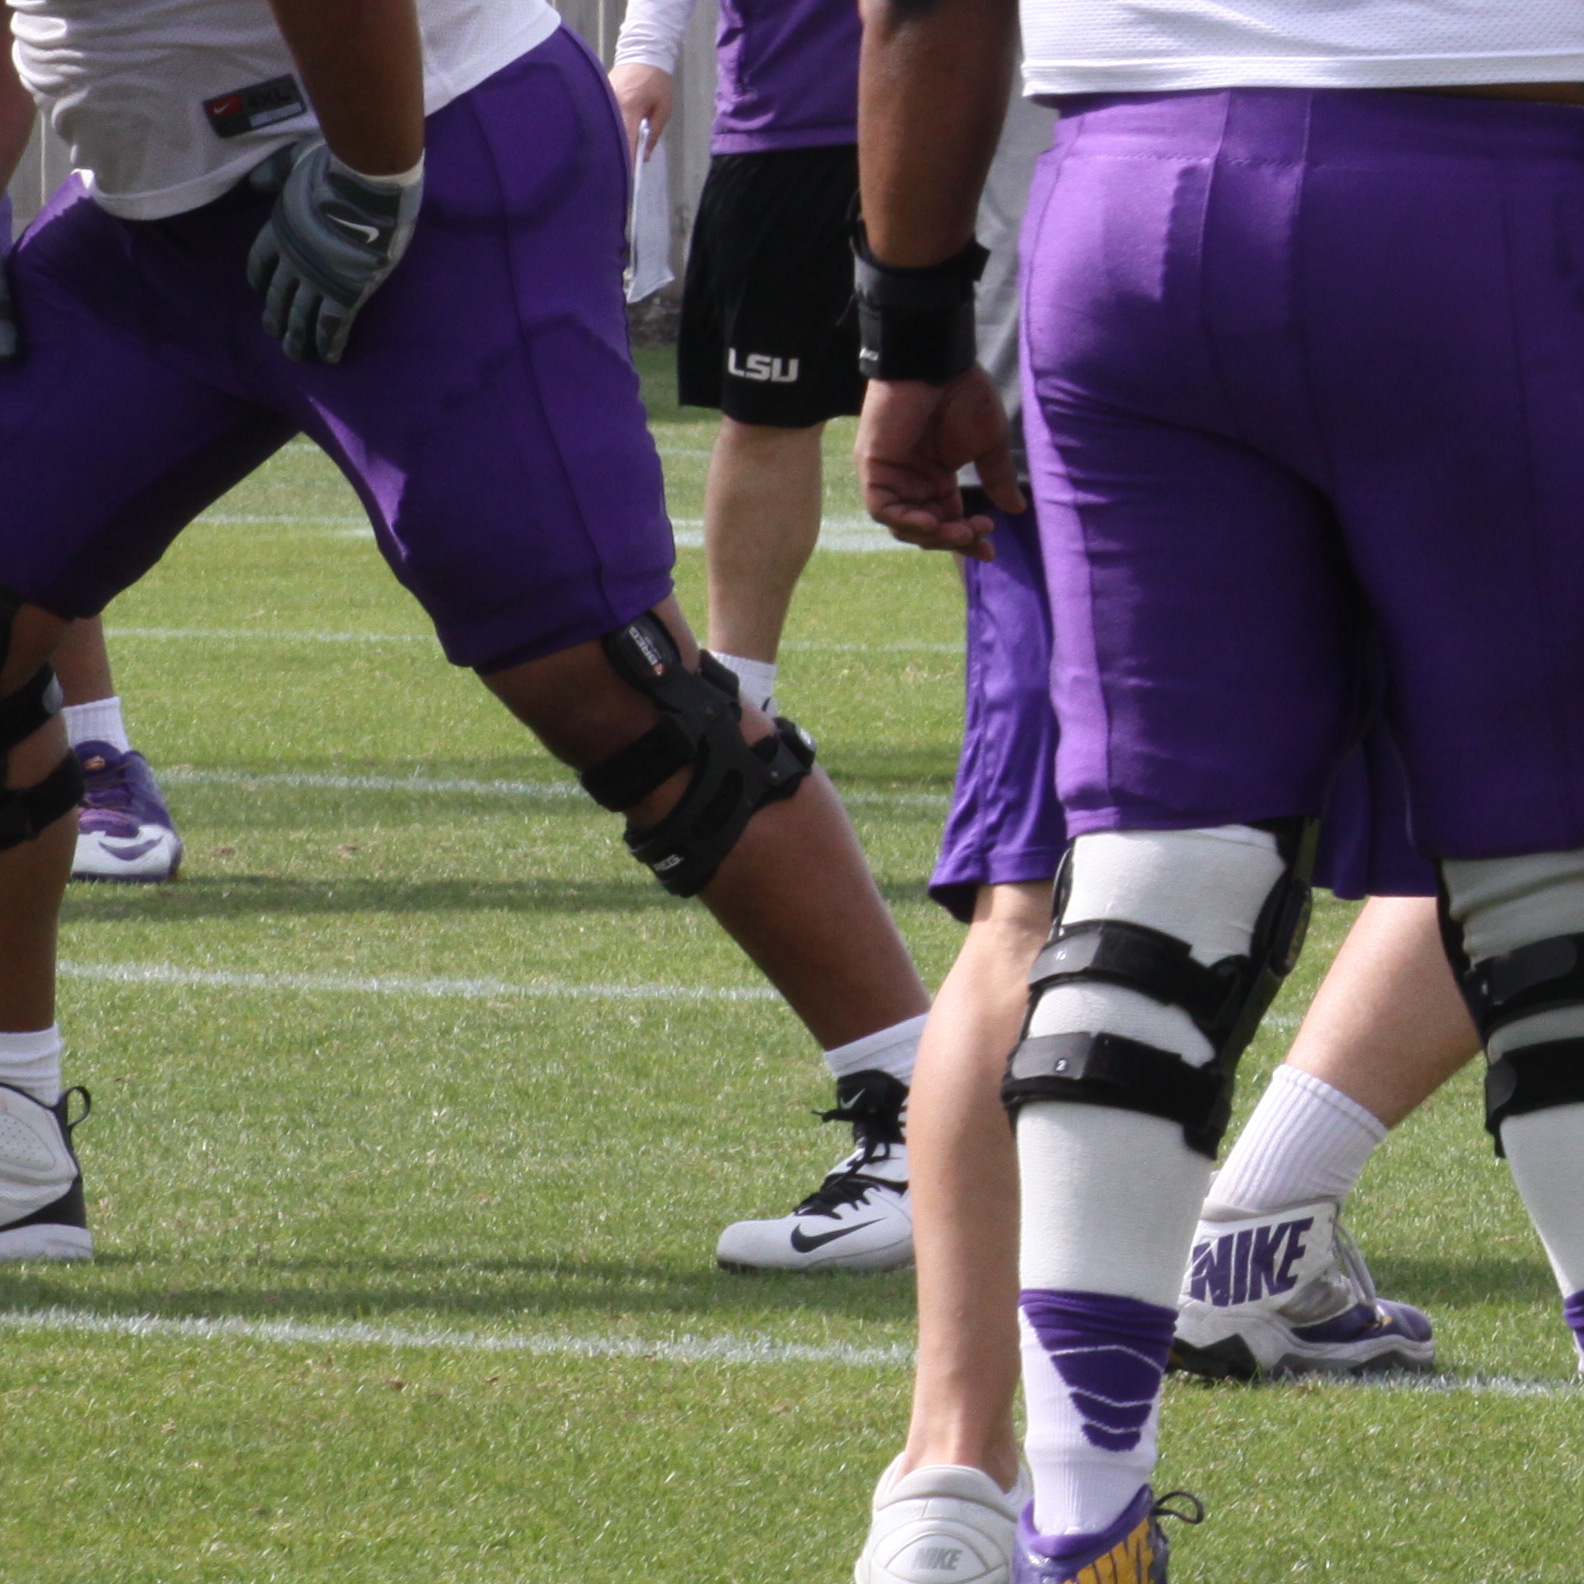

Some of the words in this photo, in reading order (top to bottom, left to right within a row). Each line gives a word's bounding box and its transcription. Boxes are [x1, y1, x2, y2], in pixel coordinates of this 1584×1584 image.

[728, 347, 799, 382] LSU
[1189, 1216, 1315, 1307] NIKE
[911, 1547, 963, 1571] NIKE
